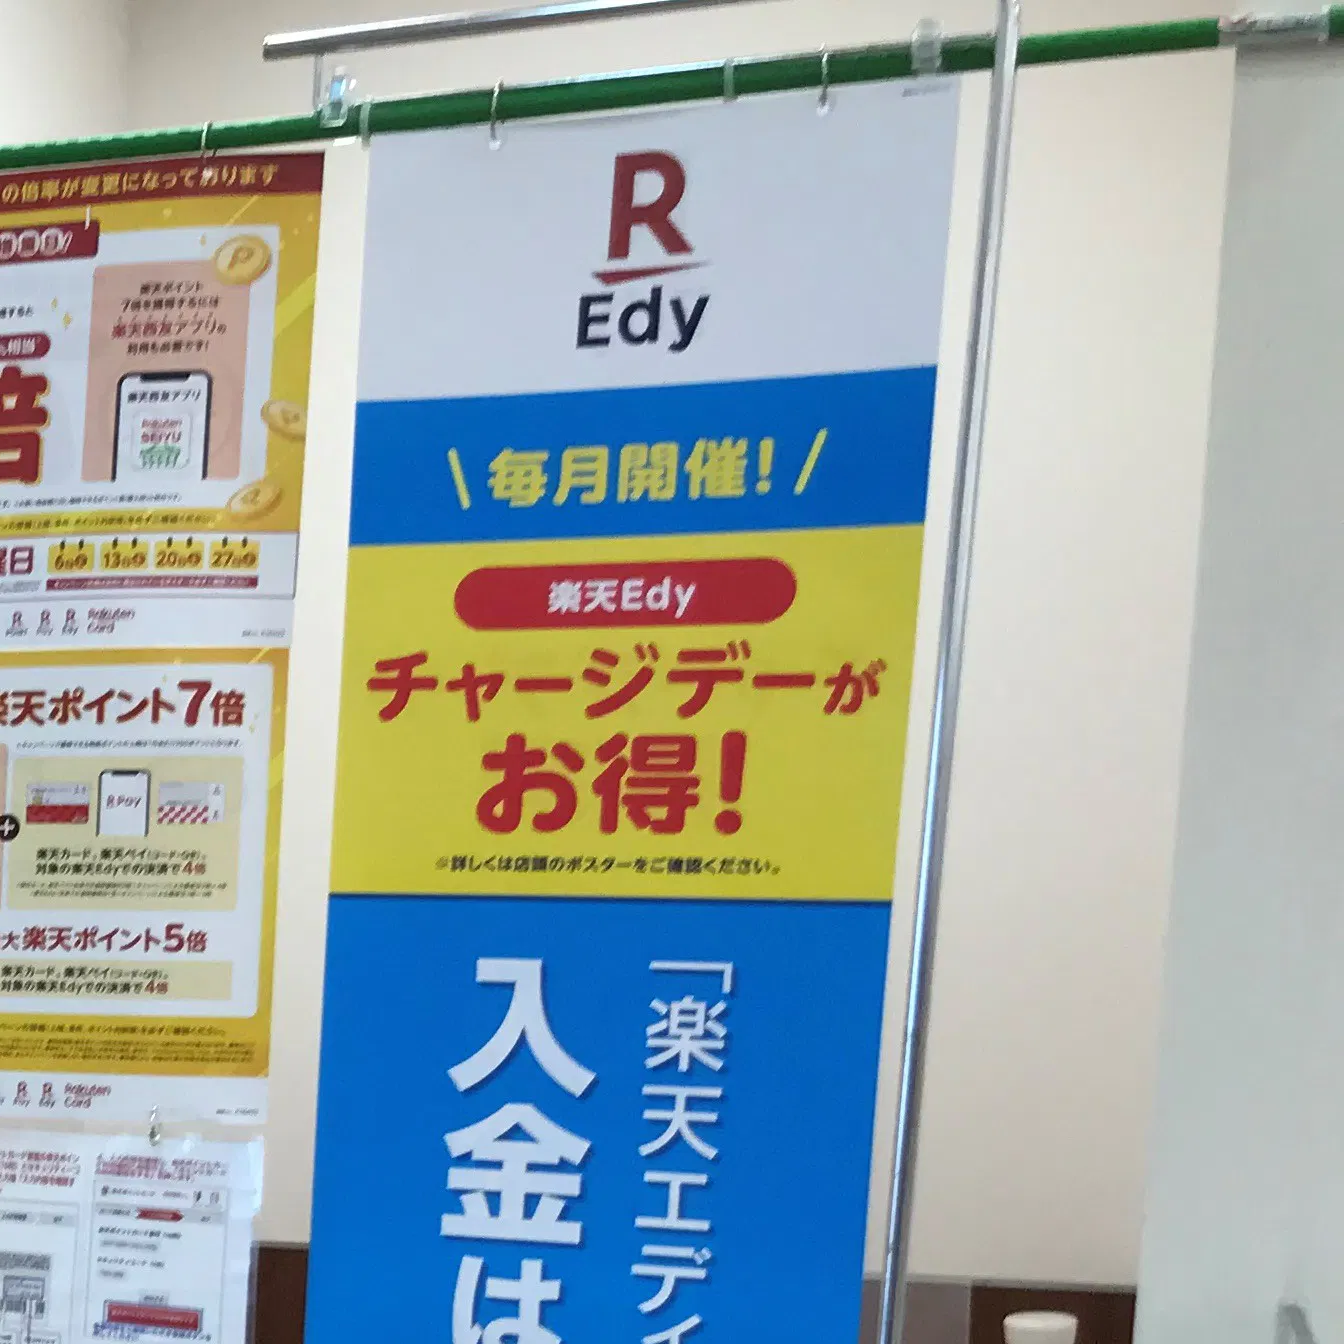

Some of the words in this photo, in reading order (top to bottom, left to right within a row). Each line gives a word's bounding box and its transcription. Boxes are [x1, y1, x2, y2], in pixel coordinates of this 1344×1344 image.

[607, 149, 693, 261] R
[575, 286, 711, 352] Edy
[486, 435, 772, 508] 毎月開催!
[546, 574, 698, 618] 楽天Edy
[366, 639, 889, 723] チャージデーが
[475, 730, 749, 836] お得!
